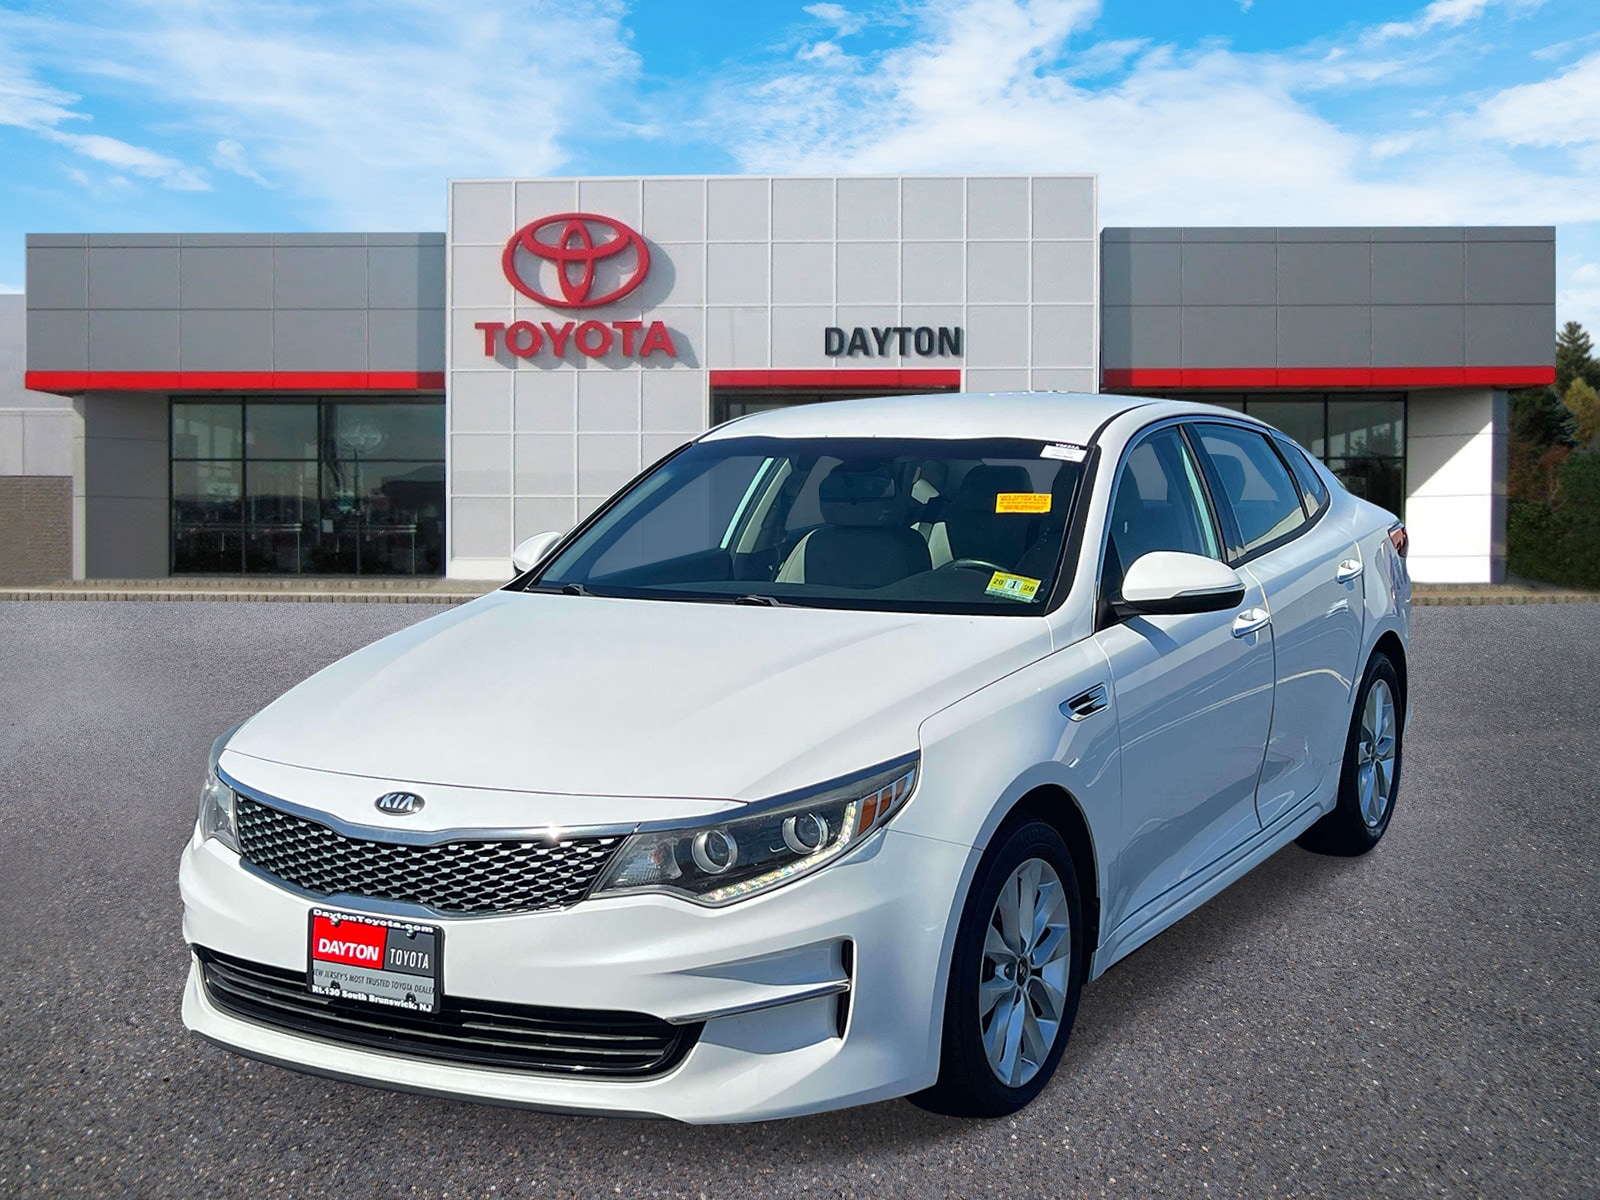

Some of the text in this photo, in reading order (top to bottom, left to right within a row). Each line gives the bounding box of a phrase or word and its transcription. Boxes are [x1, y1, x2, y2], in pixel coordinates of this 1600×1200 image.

[475, 320, 677, 358] TOYOTA
[824, 326, 963, 357] DAYTON
[380, 794, 414, 810] KIA
[318, 938, 379, 961] DAYTON
[390, 948, 429, 970] TOYOTA
[349, 974, 365, 985] MOST
[366, 977, 391, 989] TRUSTED
[391, 980, 413, 992] TOYOTA
[341, 989, 368, 1001] South
[419, 1003, 433, 1013] NJ
